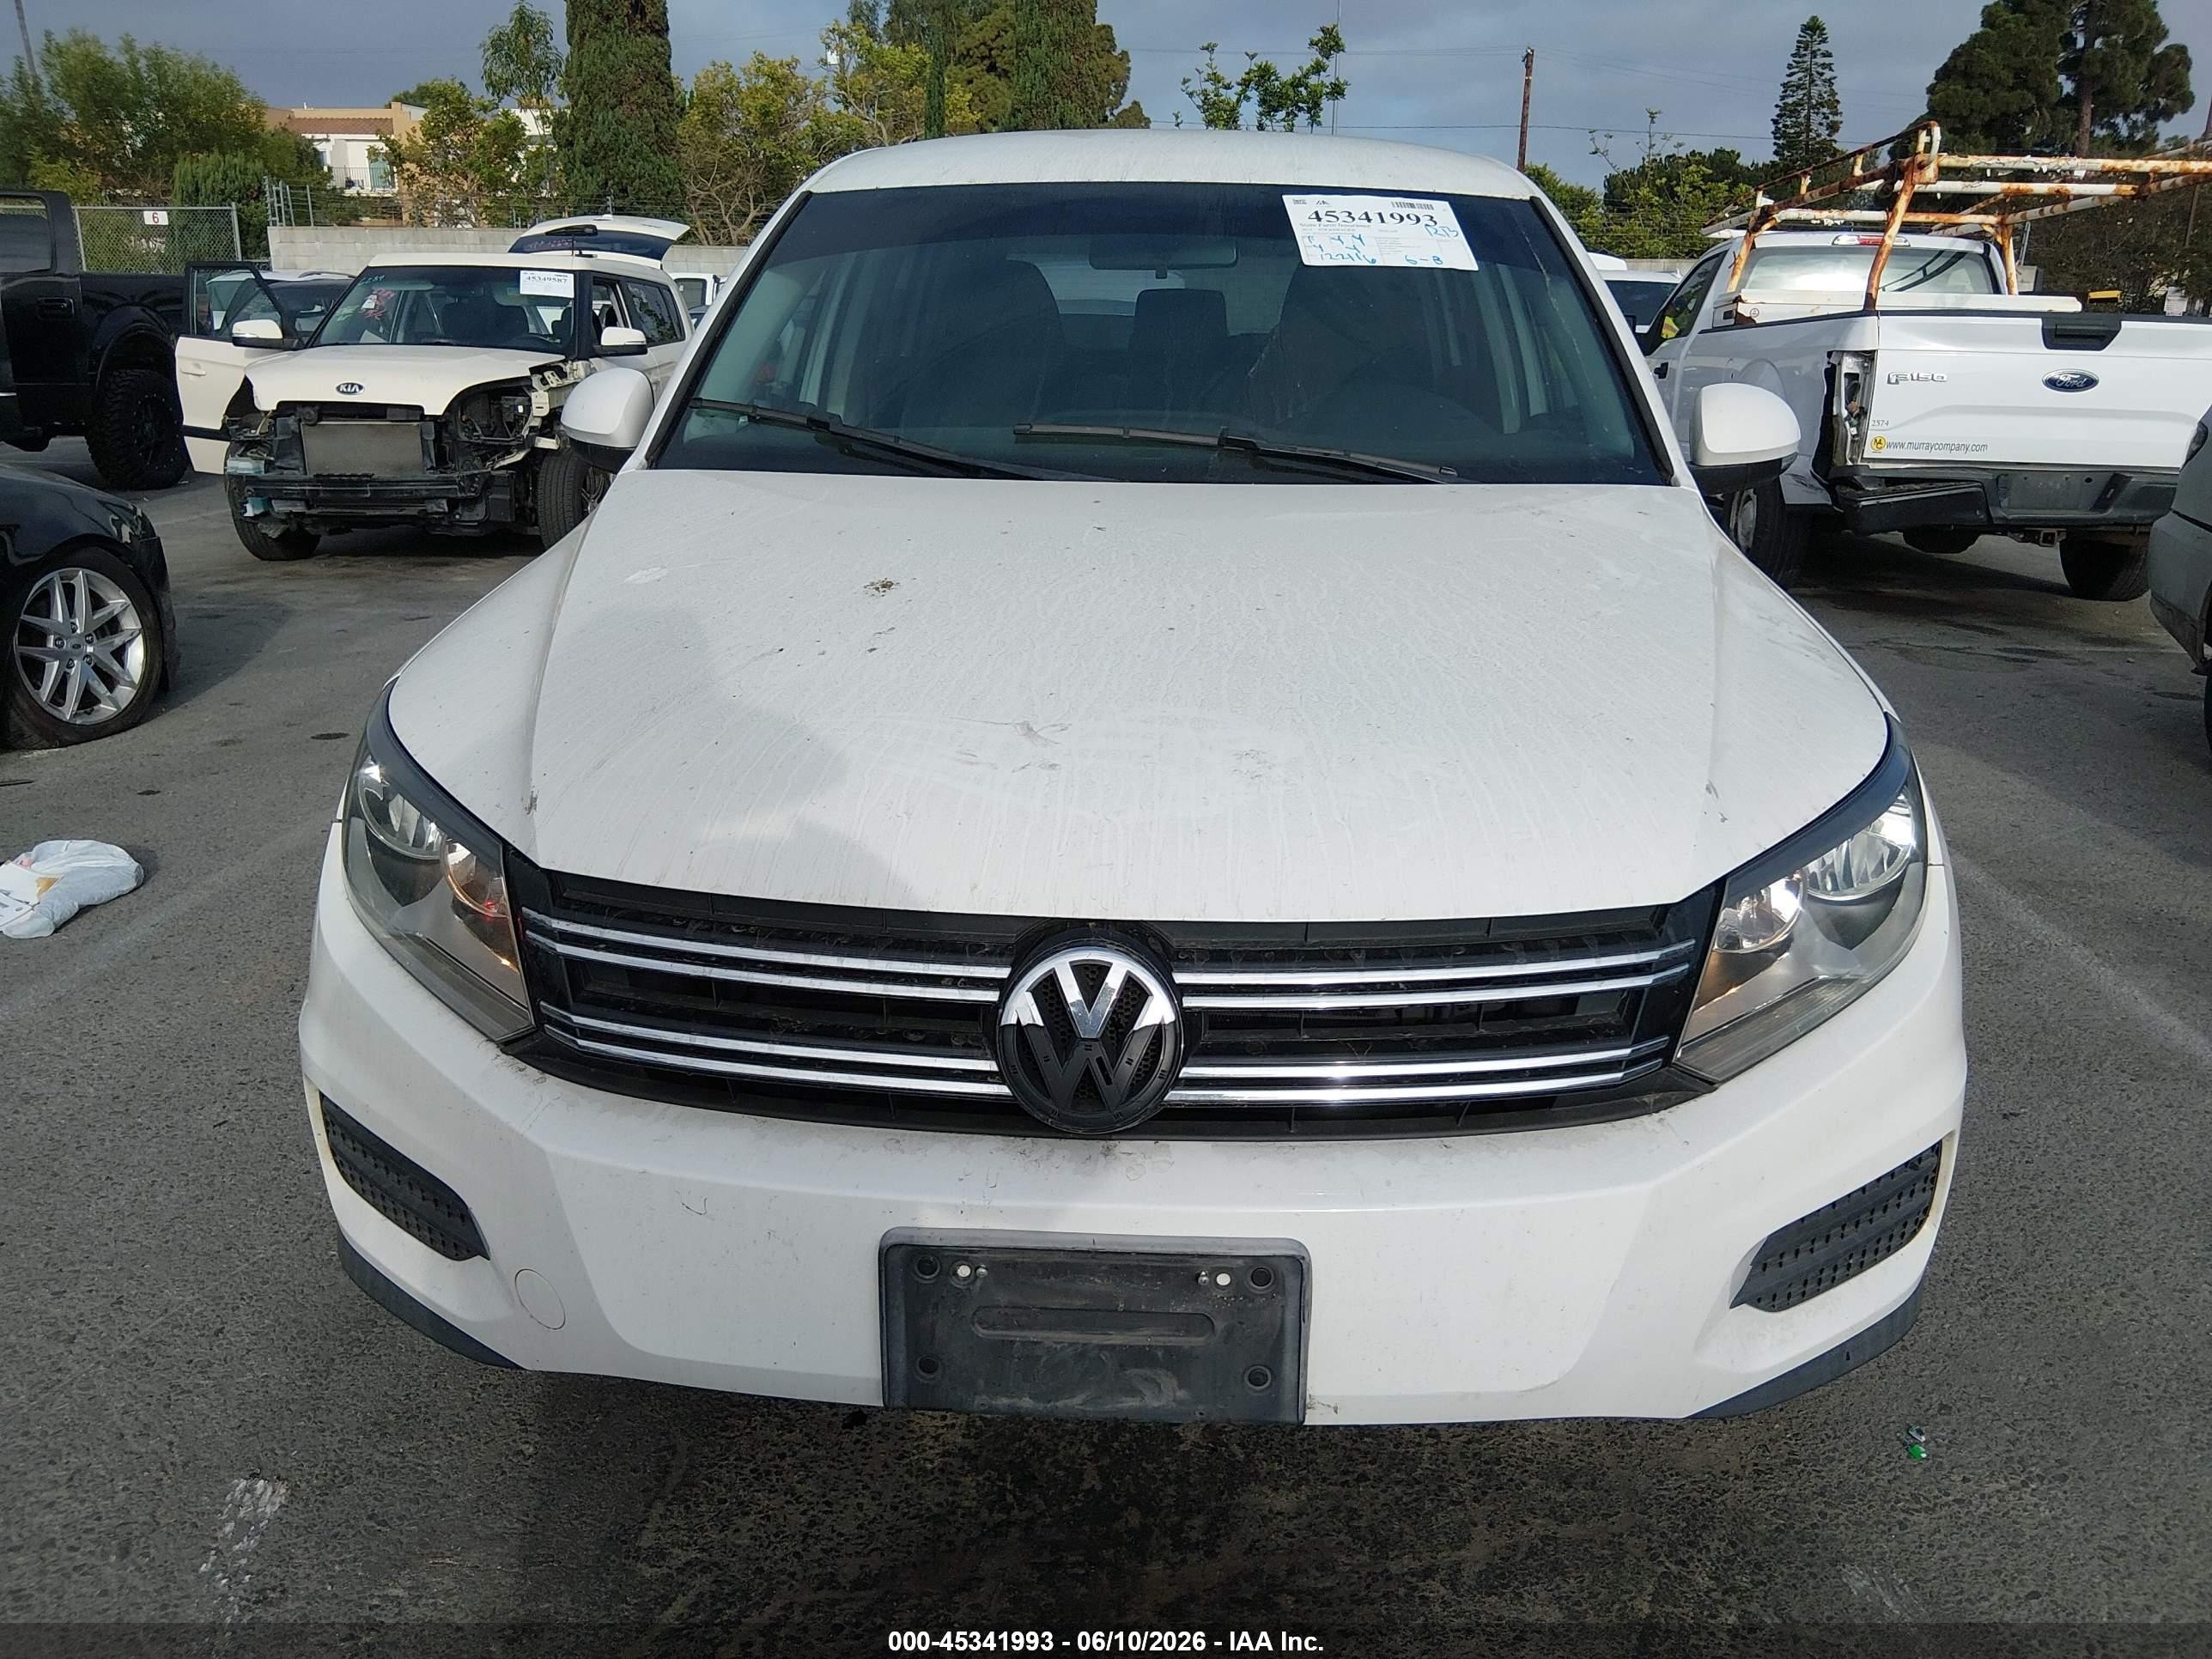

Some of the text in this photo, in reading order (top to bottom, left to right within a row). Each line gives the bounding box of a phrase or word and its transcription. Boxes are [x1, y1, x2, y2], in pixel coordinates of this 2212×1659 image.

[152, 212, 160, 223] 6
[1308, 210, 1438, 227] 45341993
[2053, 374, 2087, 387] Ford
[339, 384, 360, 392] KIA
[1886, 439, 1989, 453] www.murraycompany.com
